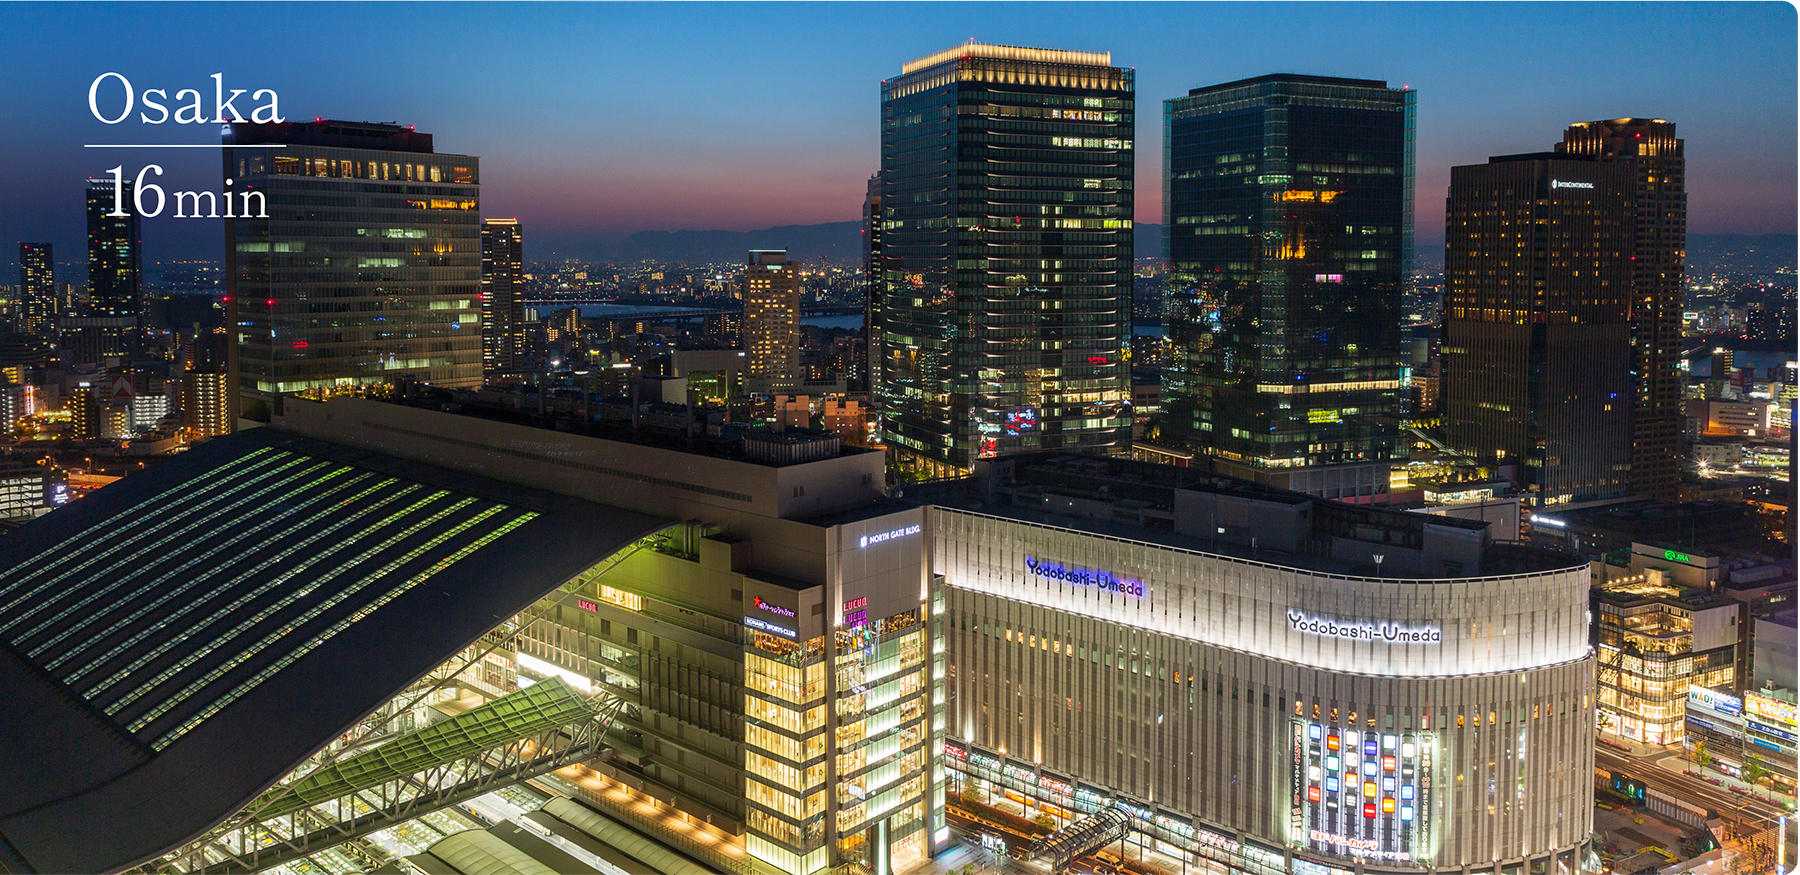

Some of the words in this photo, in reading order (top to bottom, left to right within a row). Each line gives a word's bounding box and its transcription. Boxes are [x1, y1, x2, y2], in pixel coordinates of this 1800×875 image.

[869, 532, 889, 544] NORTH
[890, 528, 905, 539] GATE
[1676, 553, 1690, 562] JRA
[1026, 559, 1143, 597] Yodobashi-Umeda
[1288, 613, 1440, 642] Yodobashi-Umeda
[1310, 829, 1379, 850] ヨドバシカメラ
